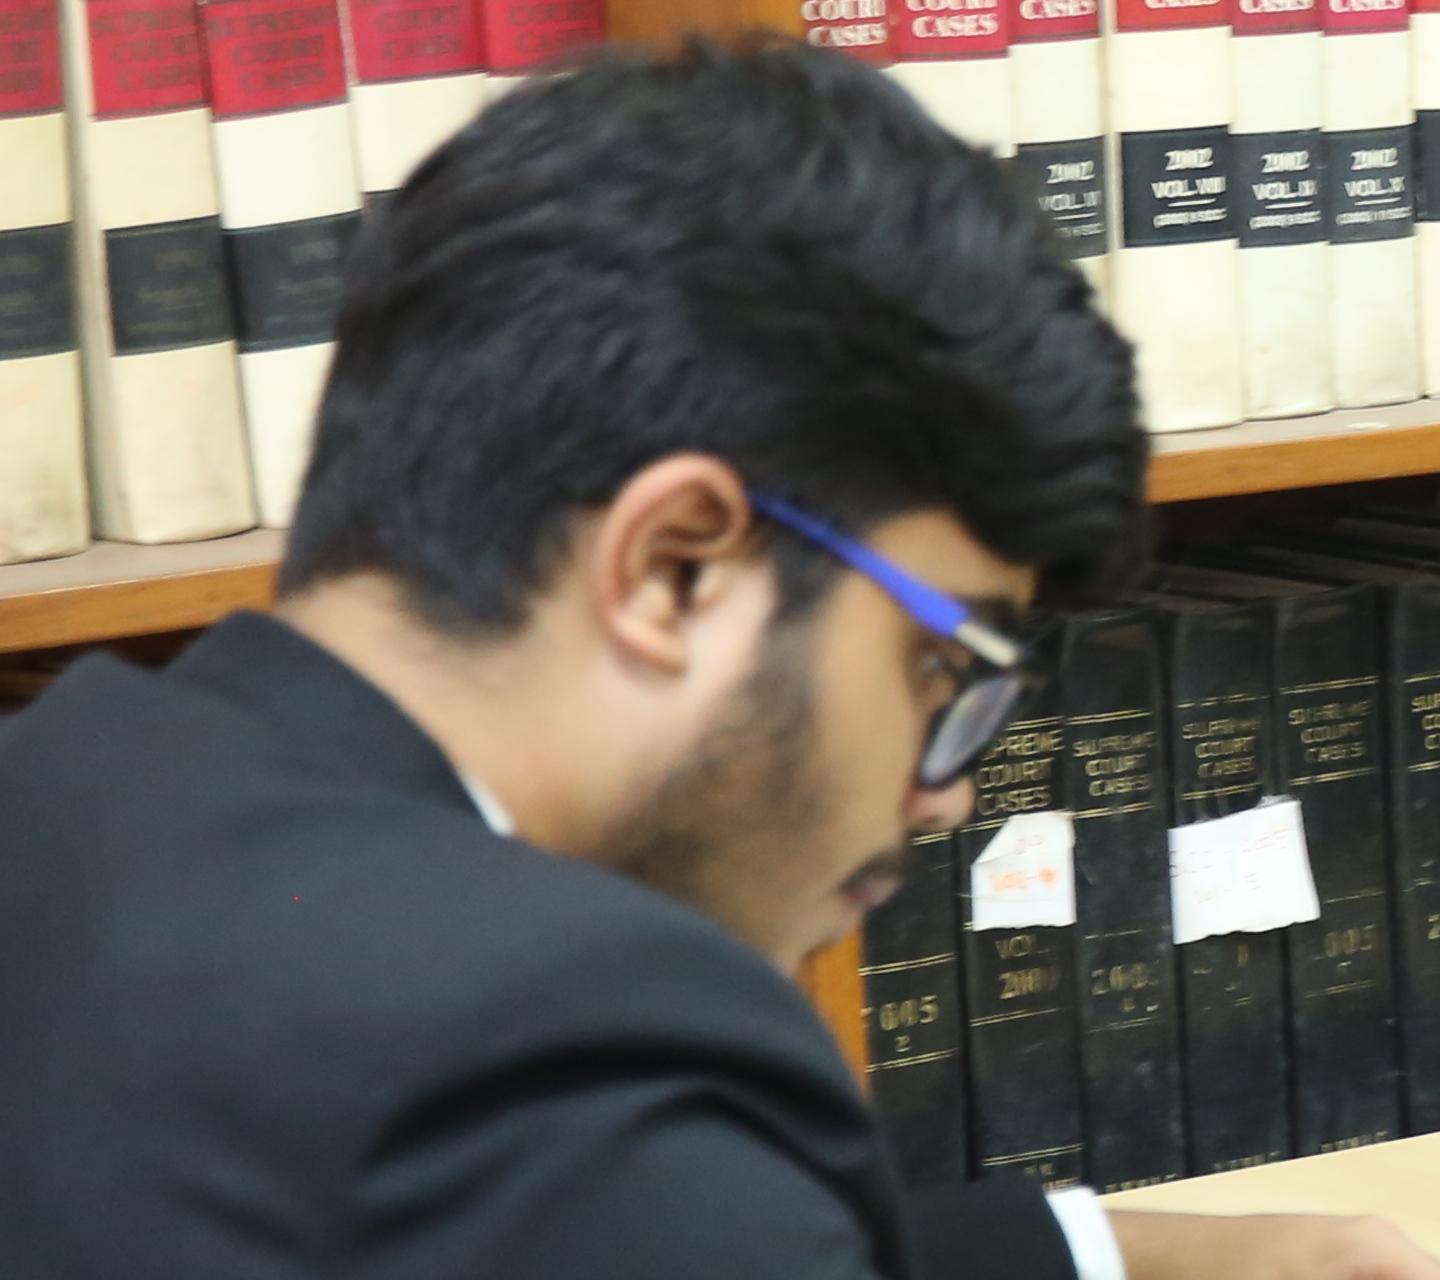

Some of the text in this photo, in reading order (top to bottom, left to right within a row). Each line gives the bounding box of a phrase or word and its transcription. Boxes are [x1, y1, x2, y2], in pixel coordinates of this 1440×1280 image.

[807, 23, 887, 47] CASES
[912, 14, 998, 38] CASES
[976, 758, 1054, 788] COURT
[976, 786, 1051, 815] CASES
